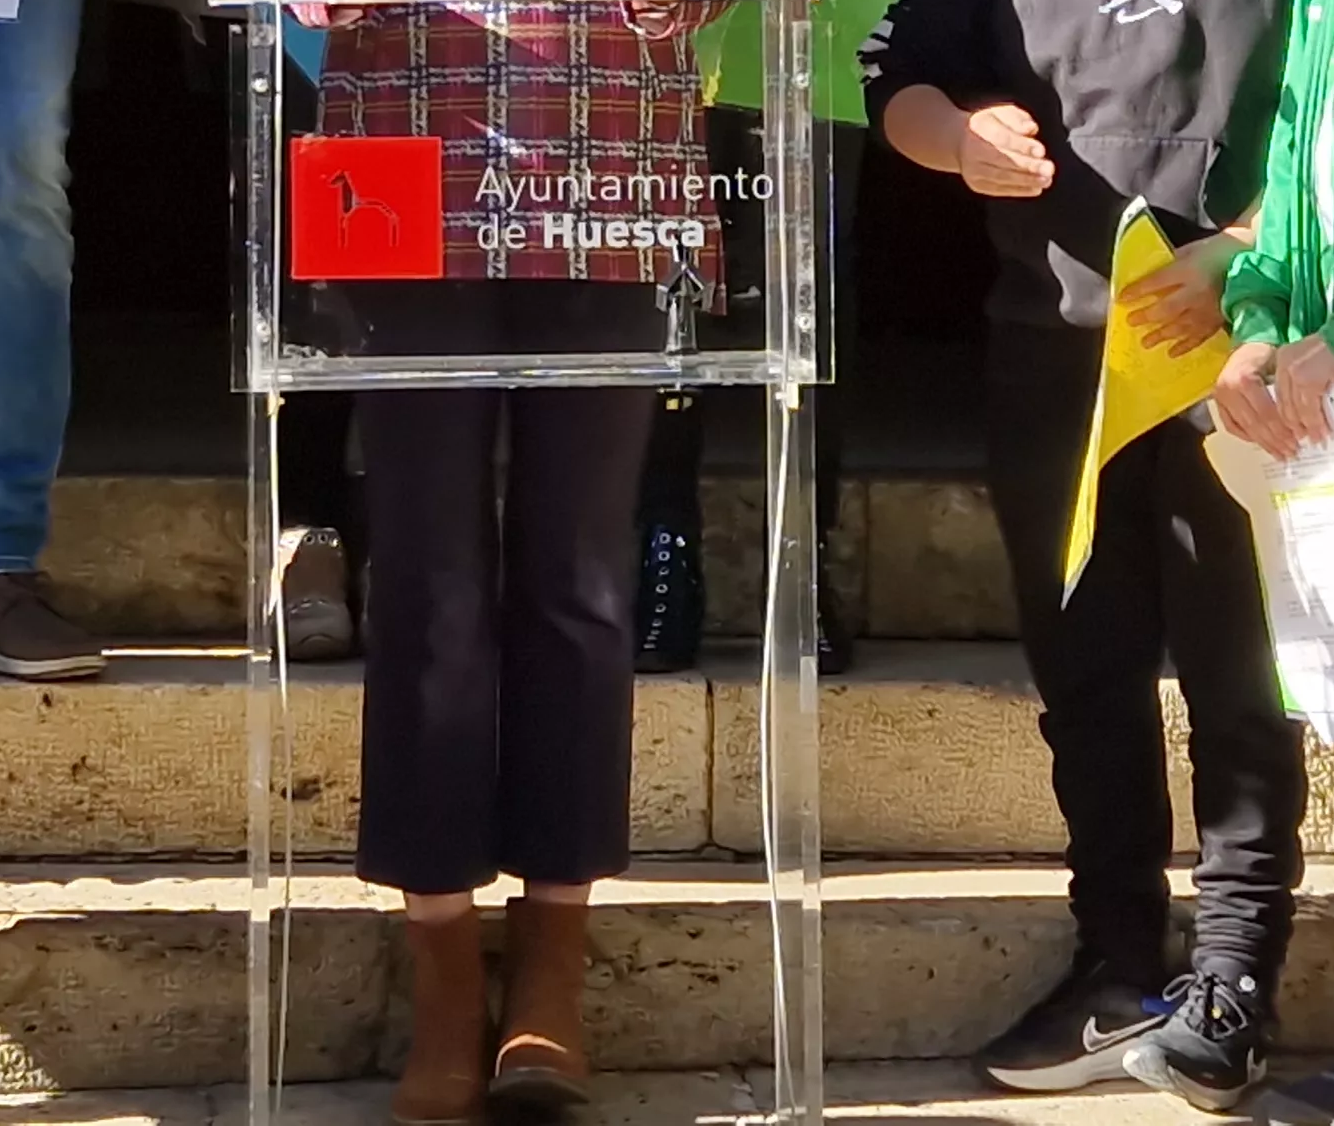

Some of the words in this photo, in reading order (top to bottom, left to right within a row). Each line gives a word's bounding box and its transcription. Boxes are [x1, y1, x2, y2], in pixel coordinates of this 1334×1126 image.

[475, 167, 774, 211] Ayuntamiento
[476, 215, 526, 250] de
[542, 215, 705, 250] Huesca
